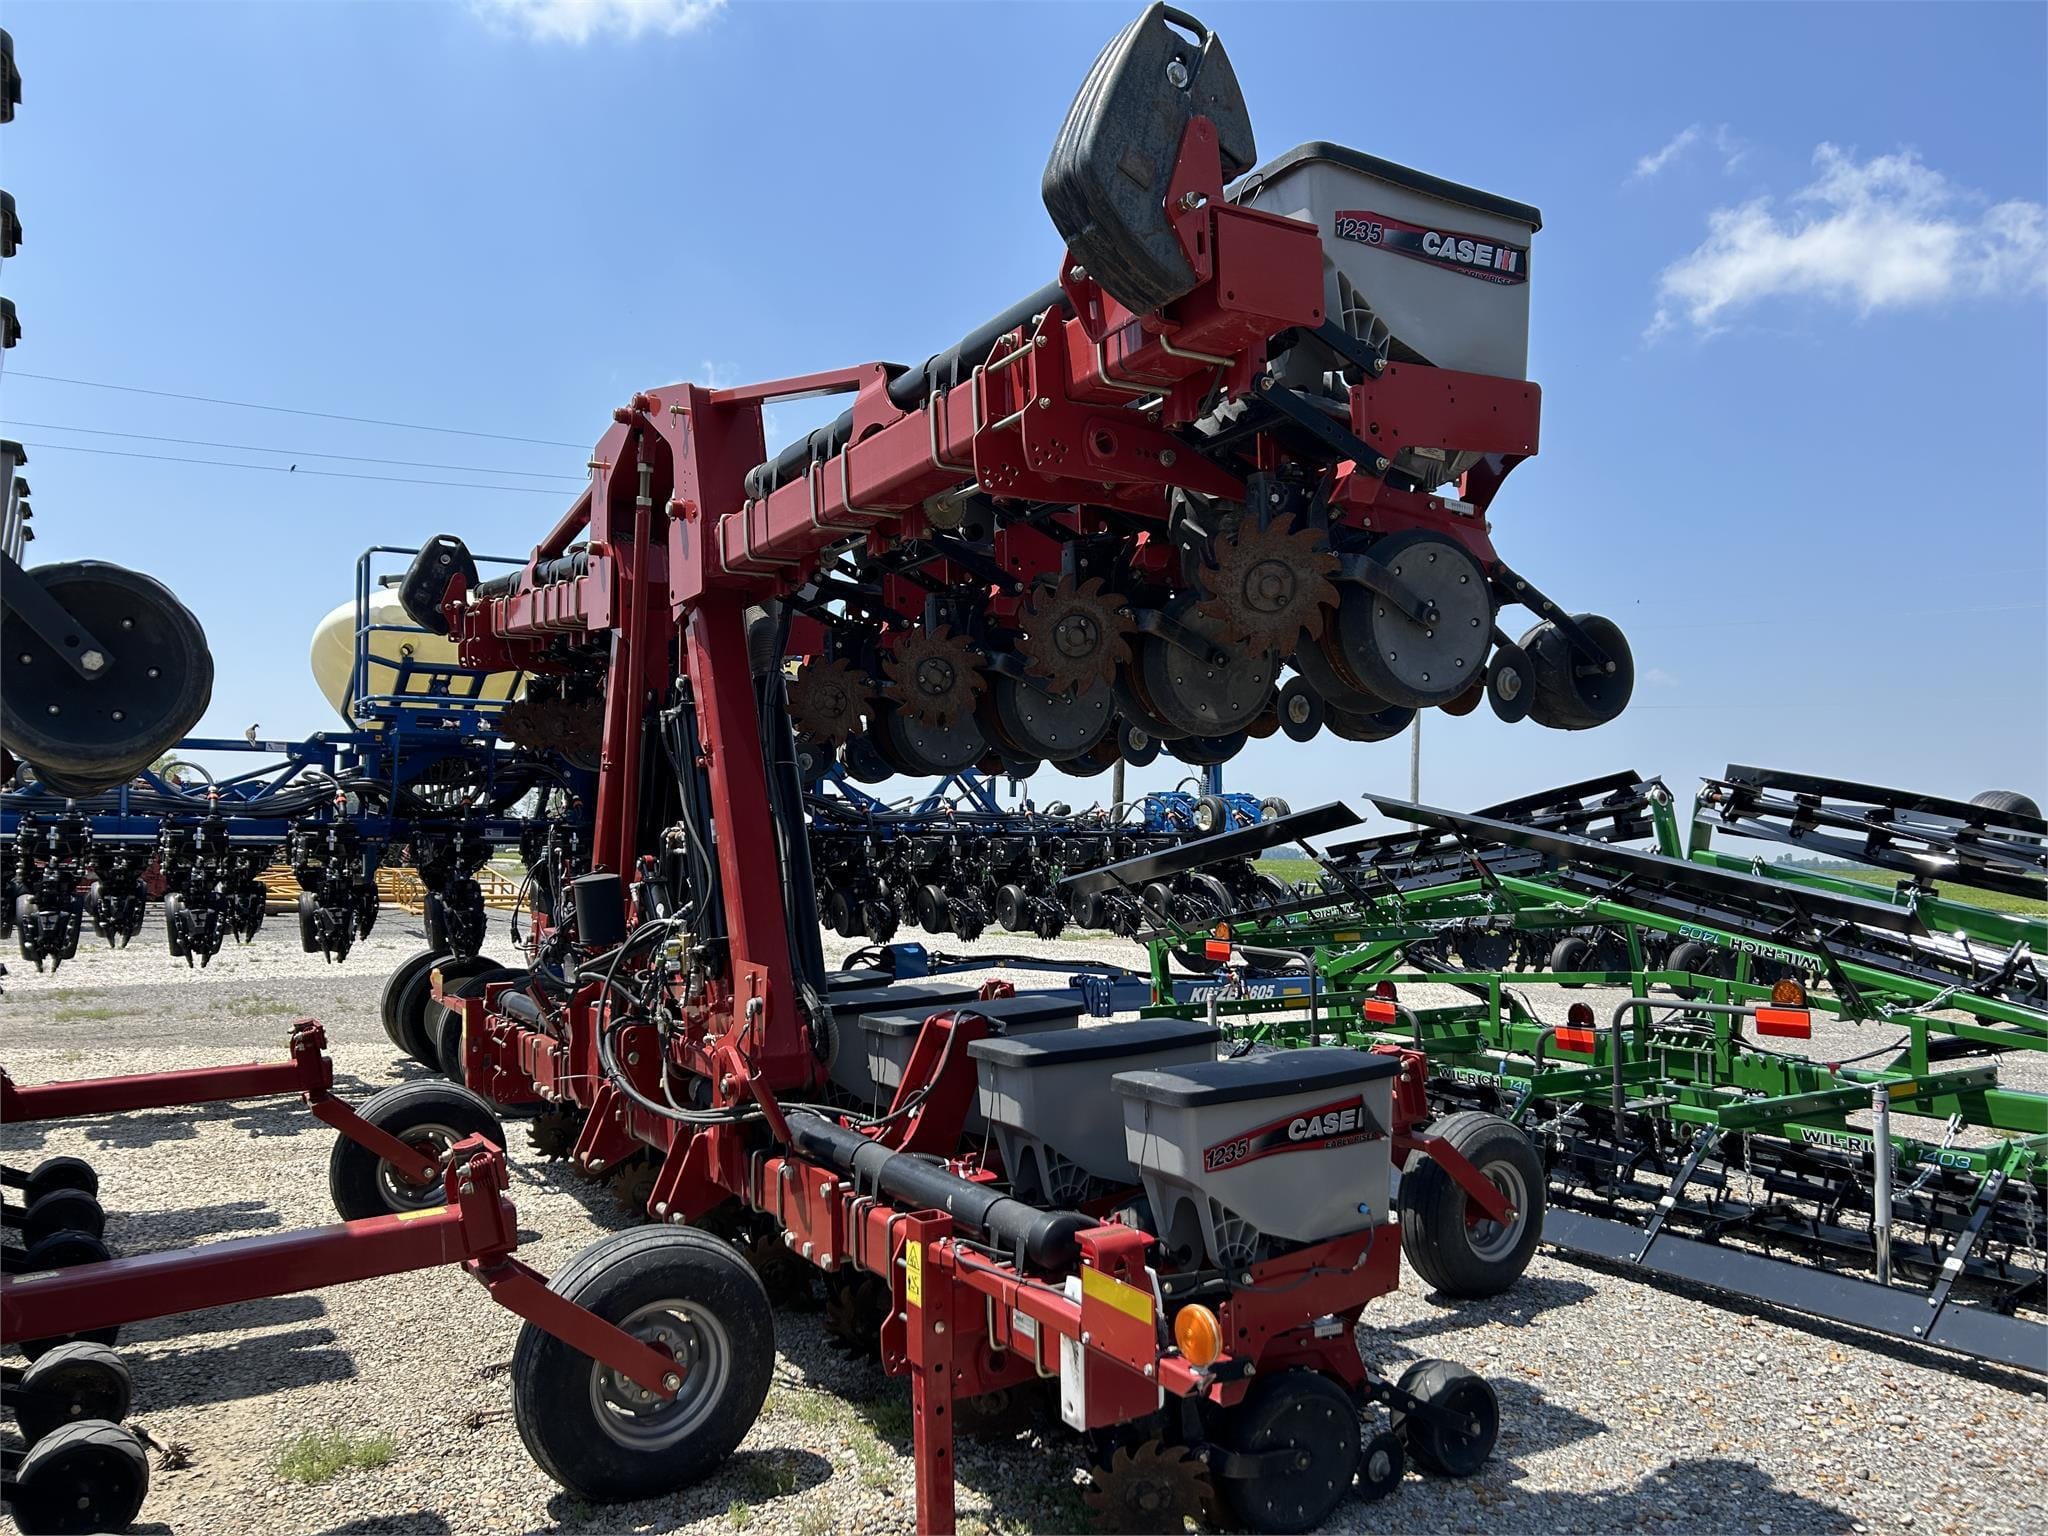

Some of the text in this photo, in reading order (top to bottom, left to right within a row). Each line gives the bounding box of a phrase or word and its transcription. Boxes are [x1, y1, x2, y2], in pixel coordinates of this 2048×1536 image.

[1336, 217, 1383, 245] 1235
[1678, 924, 1821, 971] WIL-RICH 1403
[1247, 985, 1275, 999] 605
[1206, 1137, 1249, 1170] 1235
[1917, 1148, 1972, 1170] 1403
